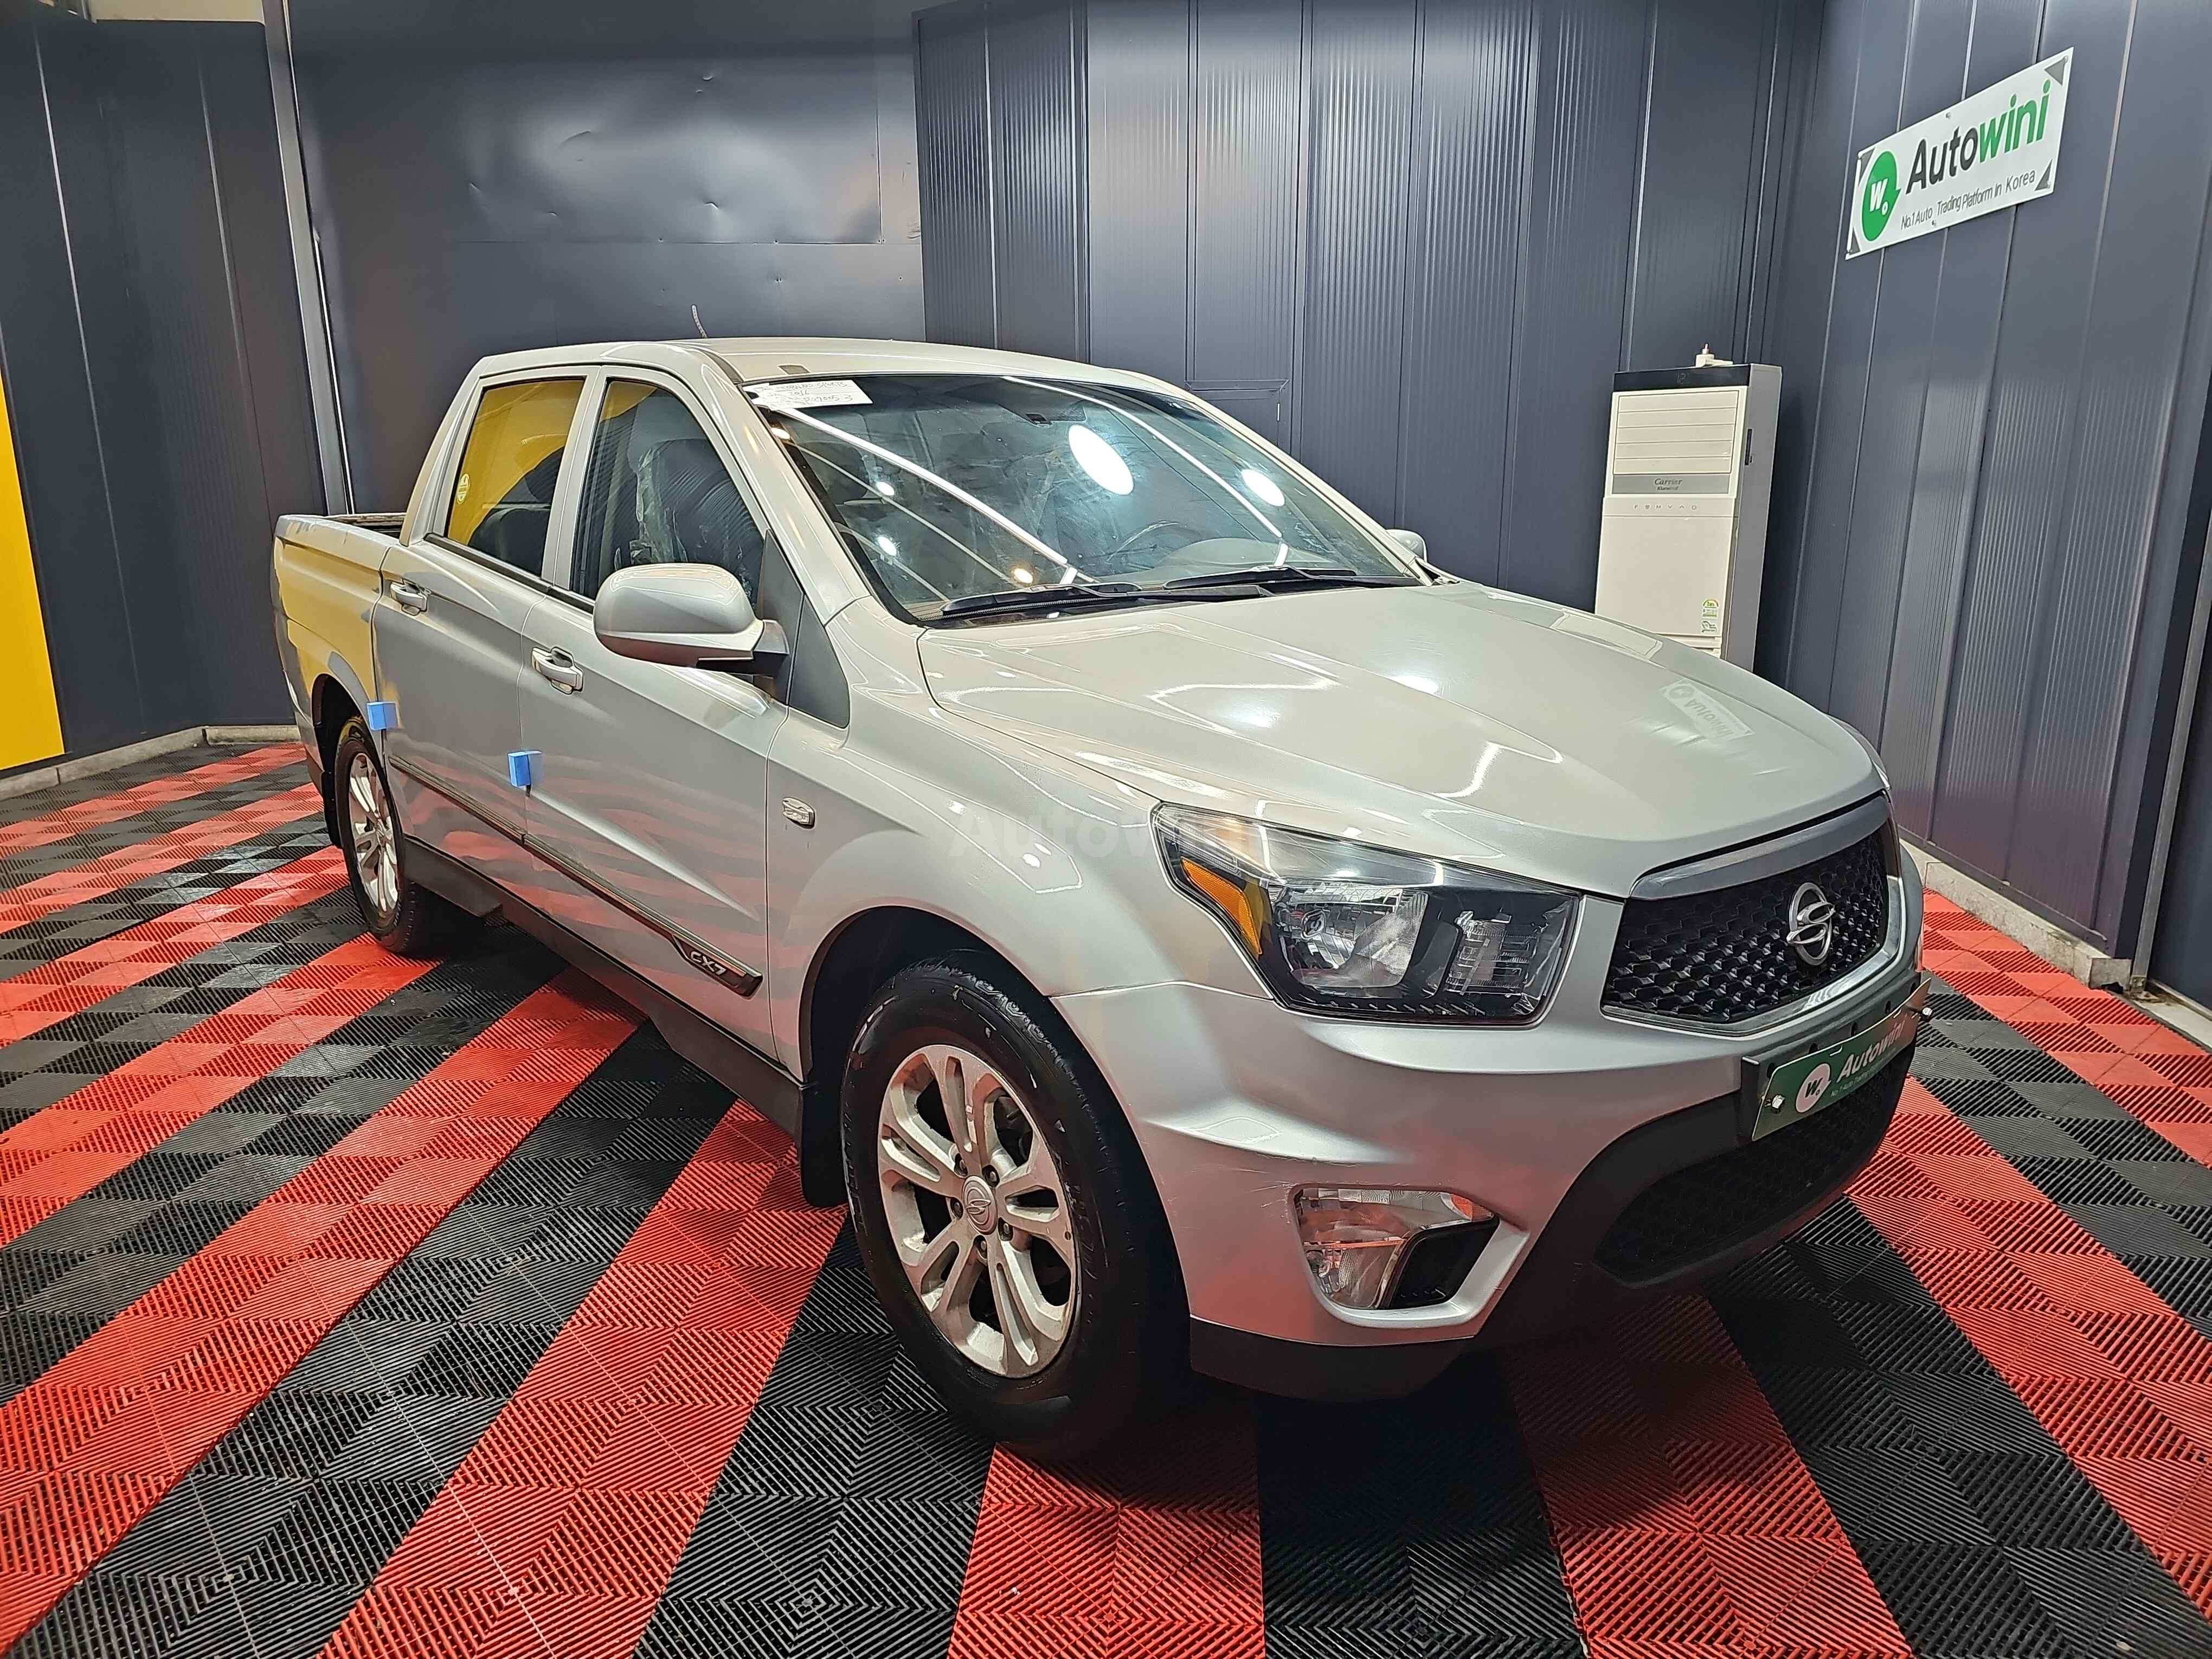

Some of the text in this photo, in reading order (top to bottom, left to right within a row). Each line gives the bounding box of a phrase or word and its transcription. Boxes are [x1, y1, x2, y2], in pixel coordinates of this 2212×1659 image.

[1905, 79, 2052, 195] Autowini
[1915, 207, 1933, 226] Auto
[1937, 195, 1962, 216] Trading
[1962, 188, 1993, 210] Platform
[2005, 170, 2036, 194] Korea
[690, 950, 727, 975] CX7
[1836, 1013, 1908, 1083] Autowini
